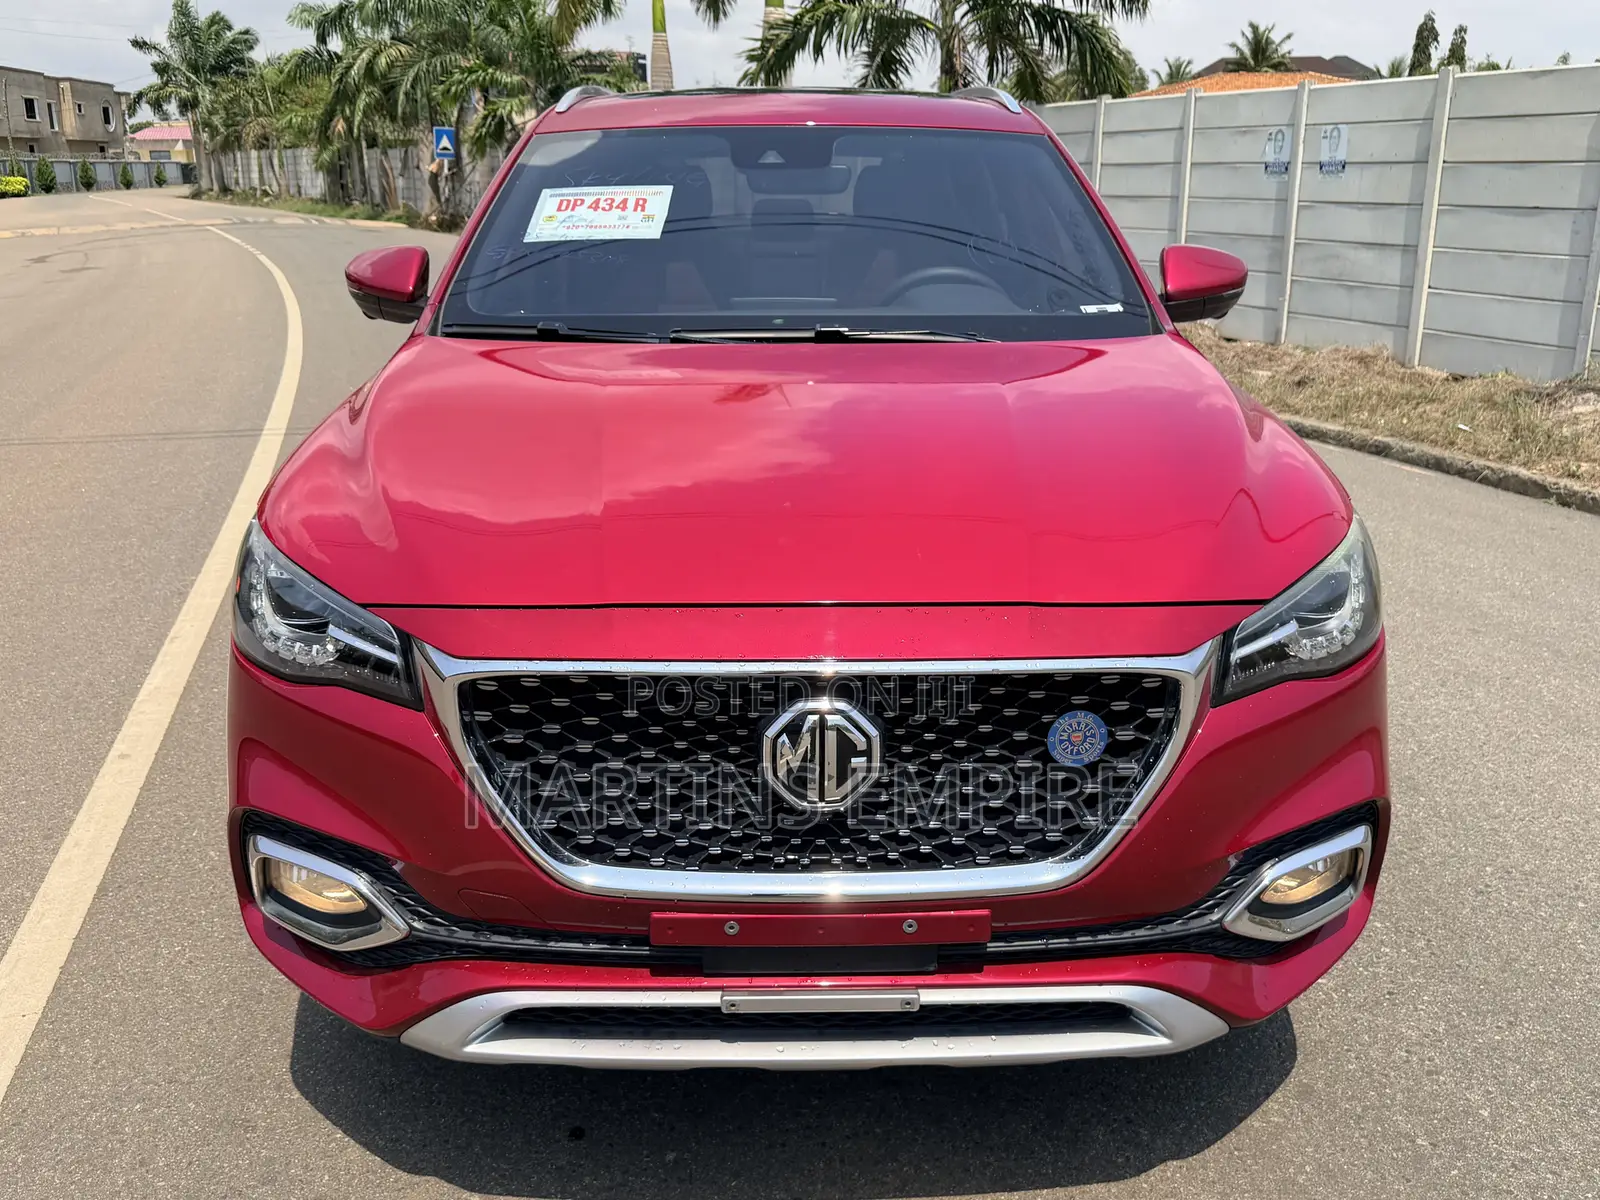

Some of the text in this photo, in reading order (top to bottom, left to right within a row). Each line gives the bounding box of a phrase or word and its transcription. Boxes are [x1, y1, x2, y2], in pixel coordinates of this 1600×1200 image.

[556, 197, 648, 213] DP 434 R
[1059, 721, 1095, 740] MORRIS
[1060, 737, 1096, 756] OXFORD
[1083, 741, 1105, 762] Sports
[776, 714, 868, 801] MG
